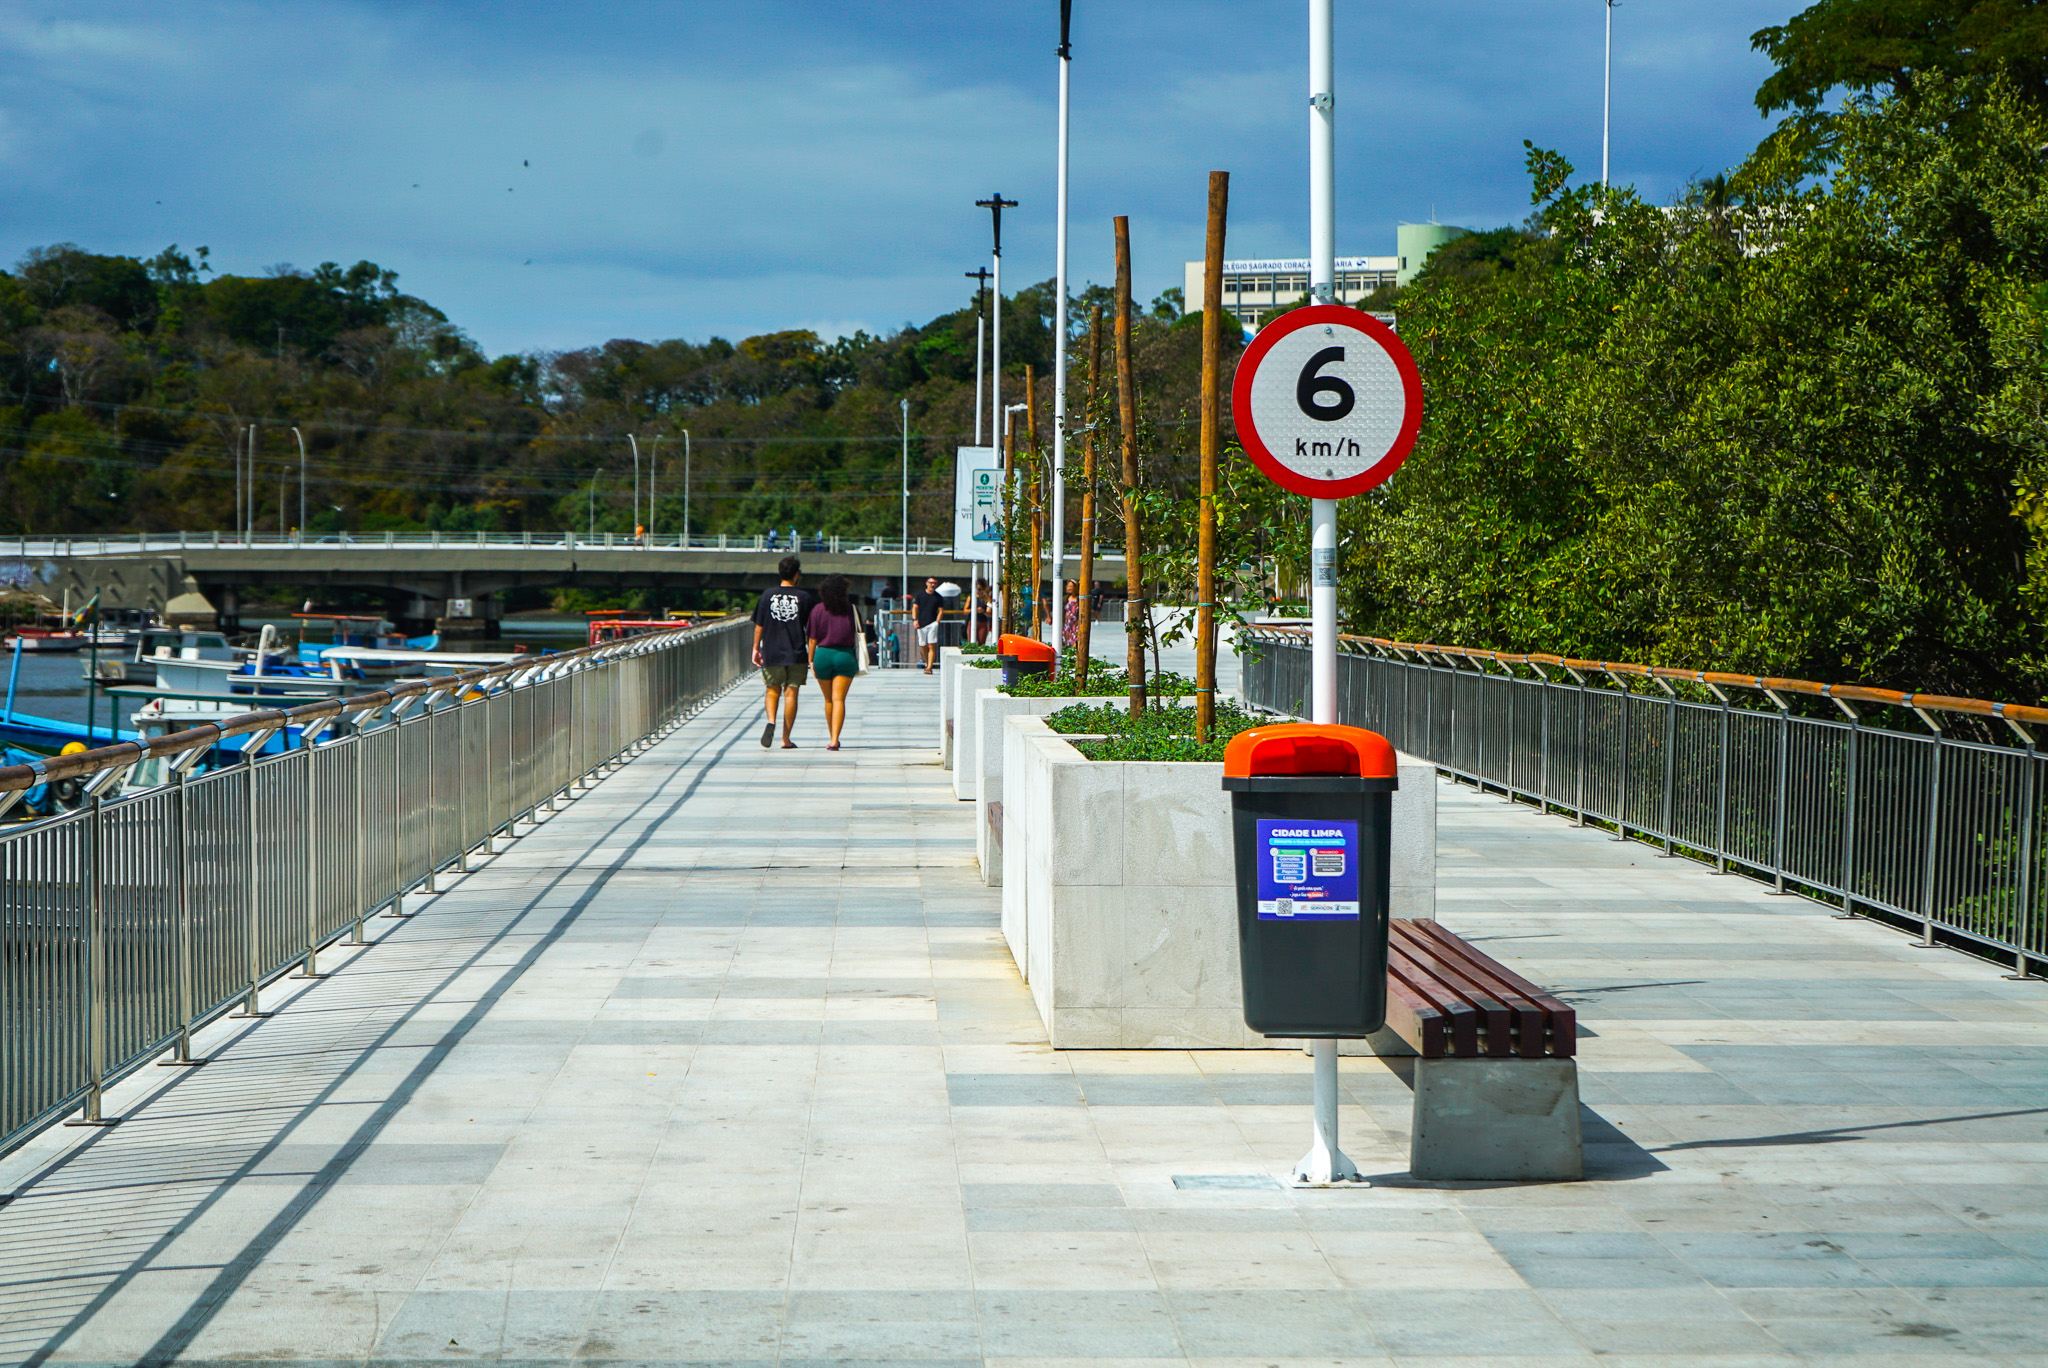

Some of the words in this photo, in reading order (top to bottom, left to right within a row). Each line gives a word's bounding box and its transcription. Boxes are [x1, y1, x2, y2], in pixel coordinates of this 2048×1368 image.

[1222, 262, 1247, 270] OLÉGIO
[1249, 261, 1282, 270] SAGRADO
[1284, 260, 1311, 269] CORAÇÃ
[1296, 346, 1355, 422] 6
[1295, 437, 1360, 456] km/h
[1271, 829, 1309, 837] CIDADE
[1311, 829, 1343, 837] LIMPA
